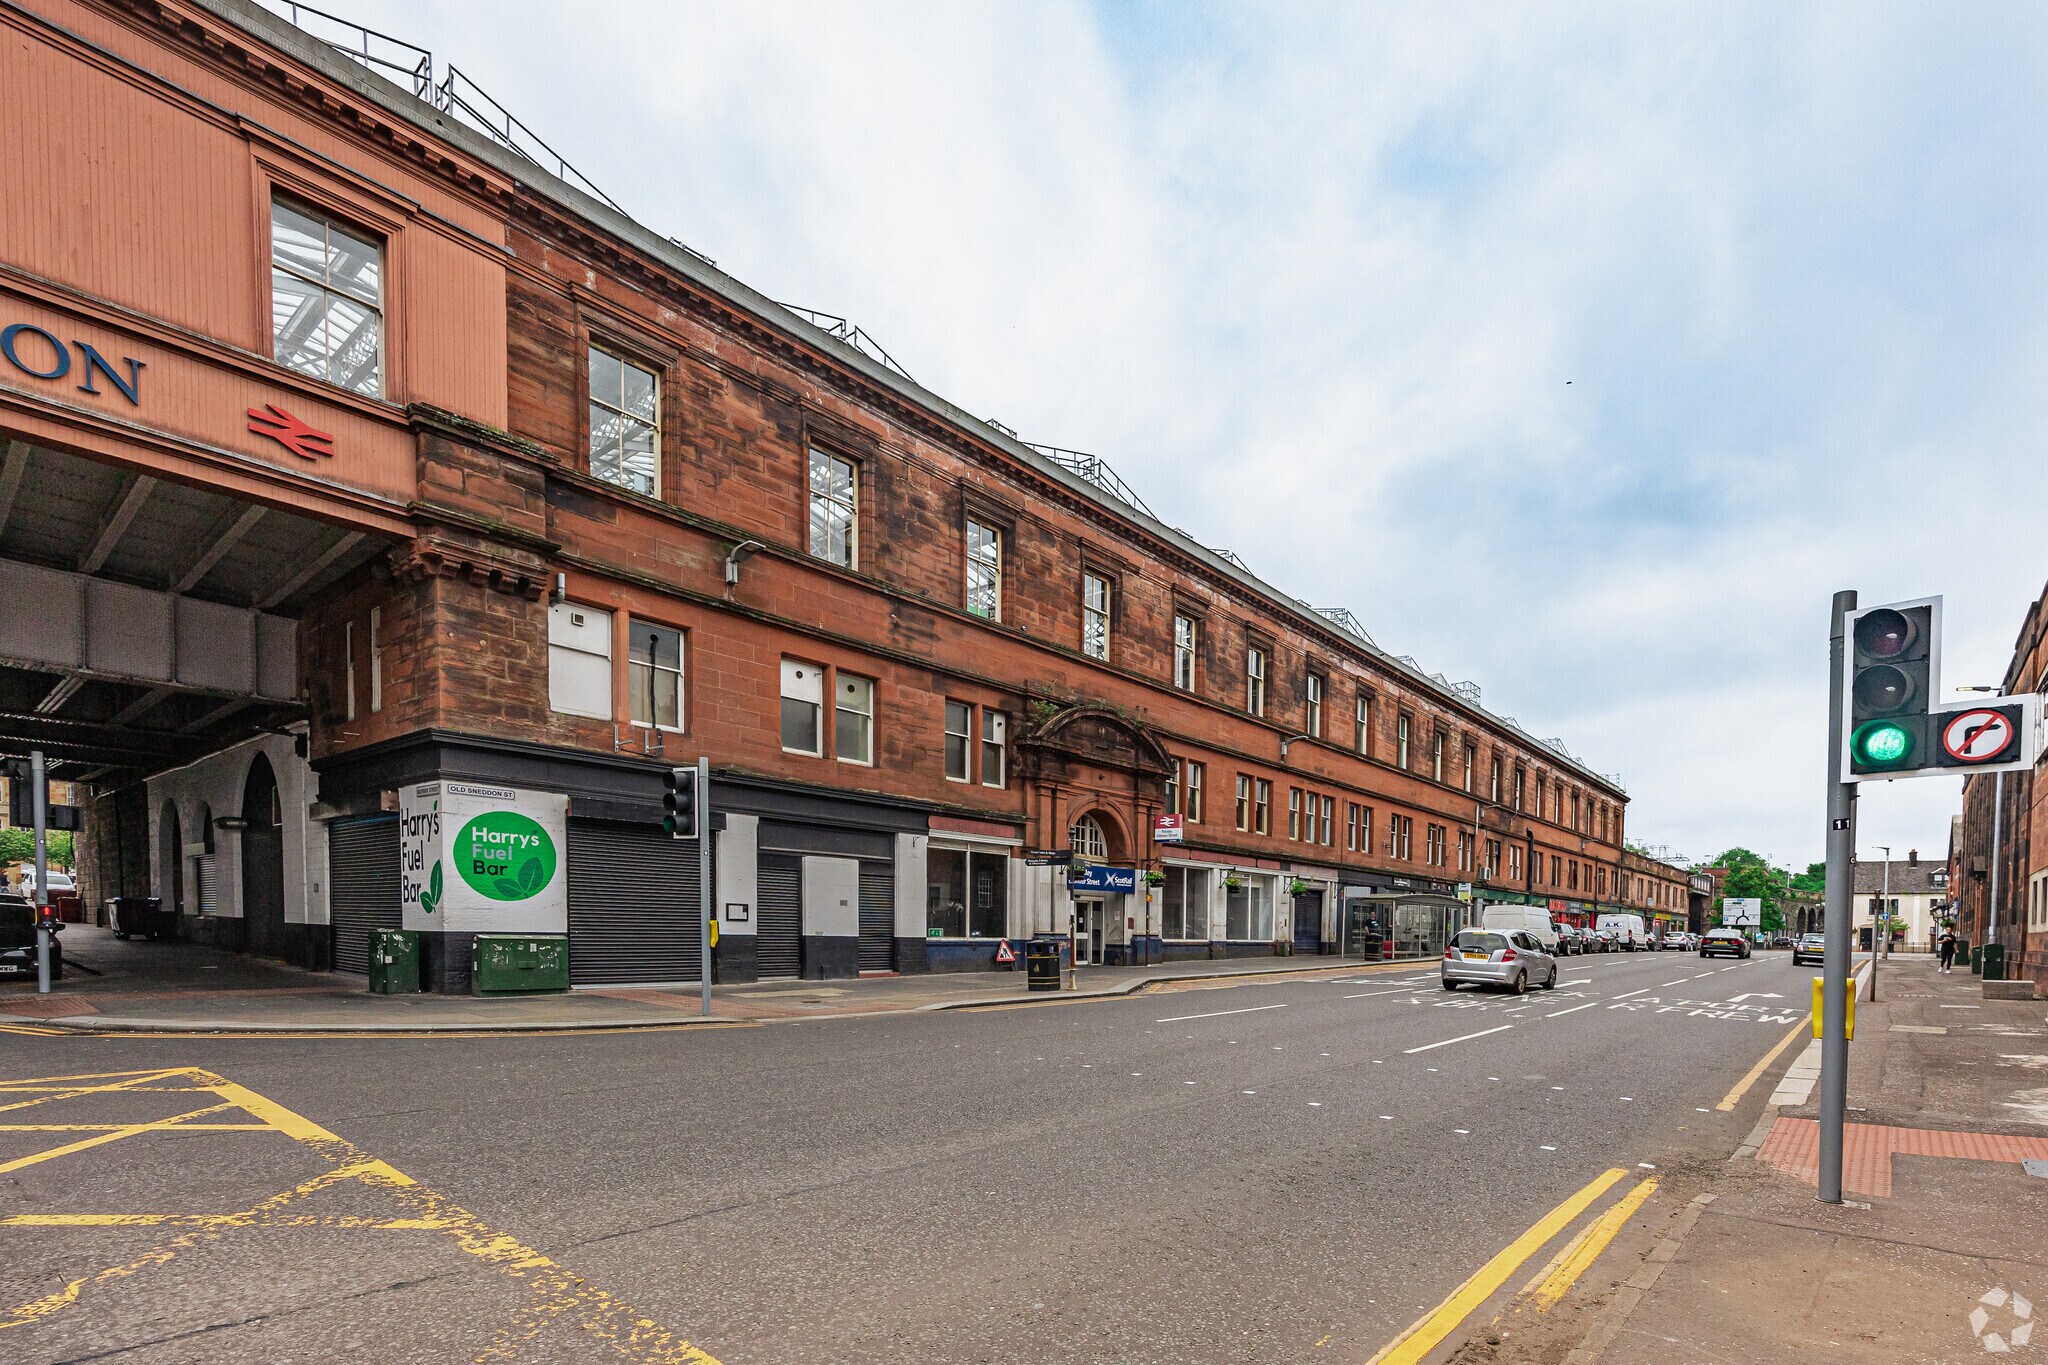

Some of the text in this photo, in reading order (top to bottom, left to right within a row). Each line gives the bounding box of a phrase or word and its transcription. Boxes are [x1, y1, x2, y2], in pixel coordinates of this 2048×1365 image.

[1, 323, 146, 407] ON
[450, 785, 466, 793] OLD
[467, 788, 503, 797] SNEDDON
[402, 840, 424, 872] Fuel
[472, 843, 513, 861] Fuel
[473, 860, 508, 876] Bar
[402, 875, 422, 904] Bar
[1114, 876, 1133, 885] ScotRail
